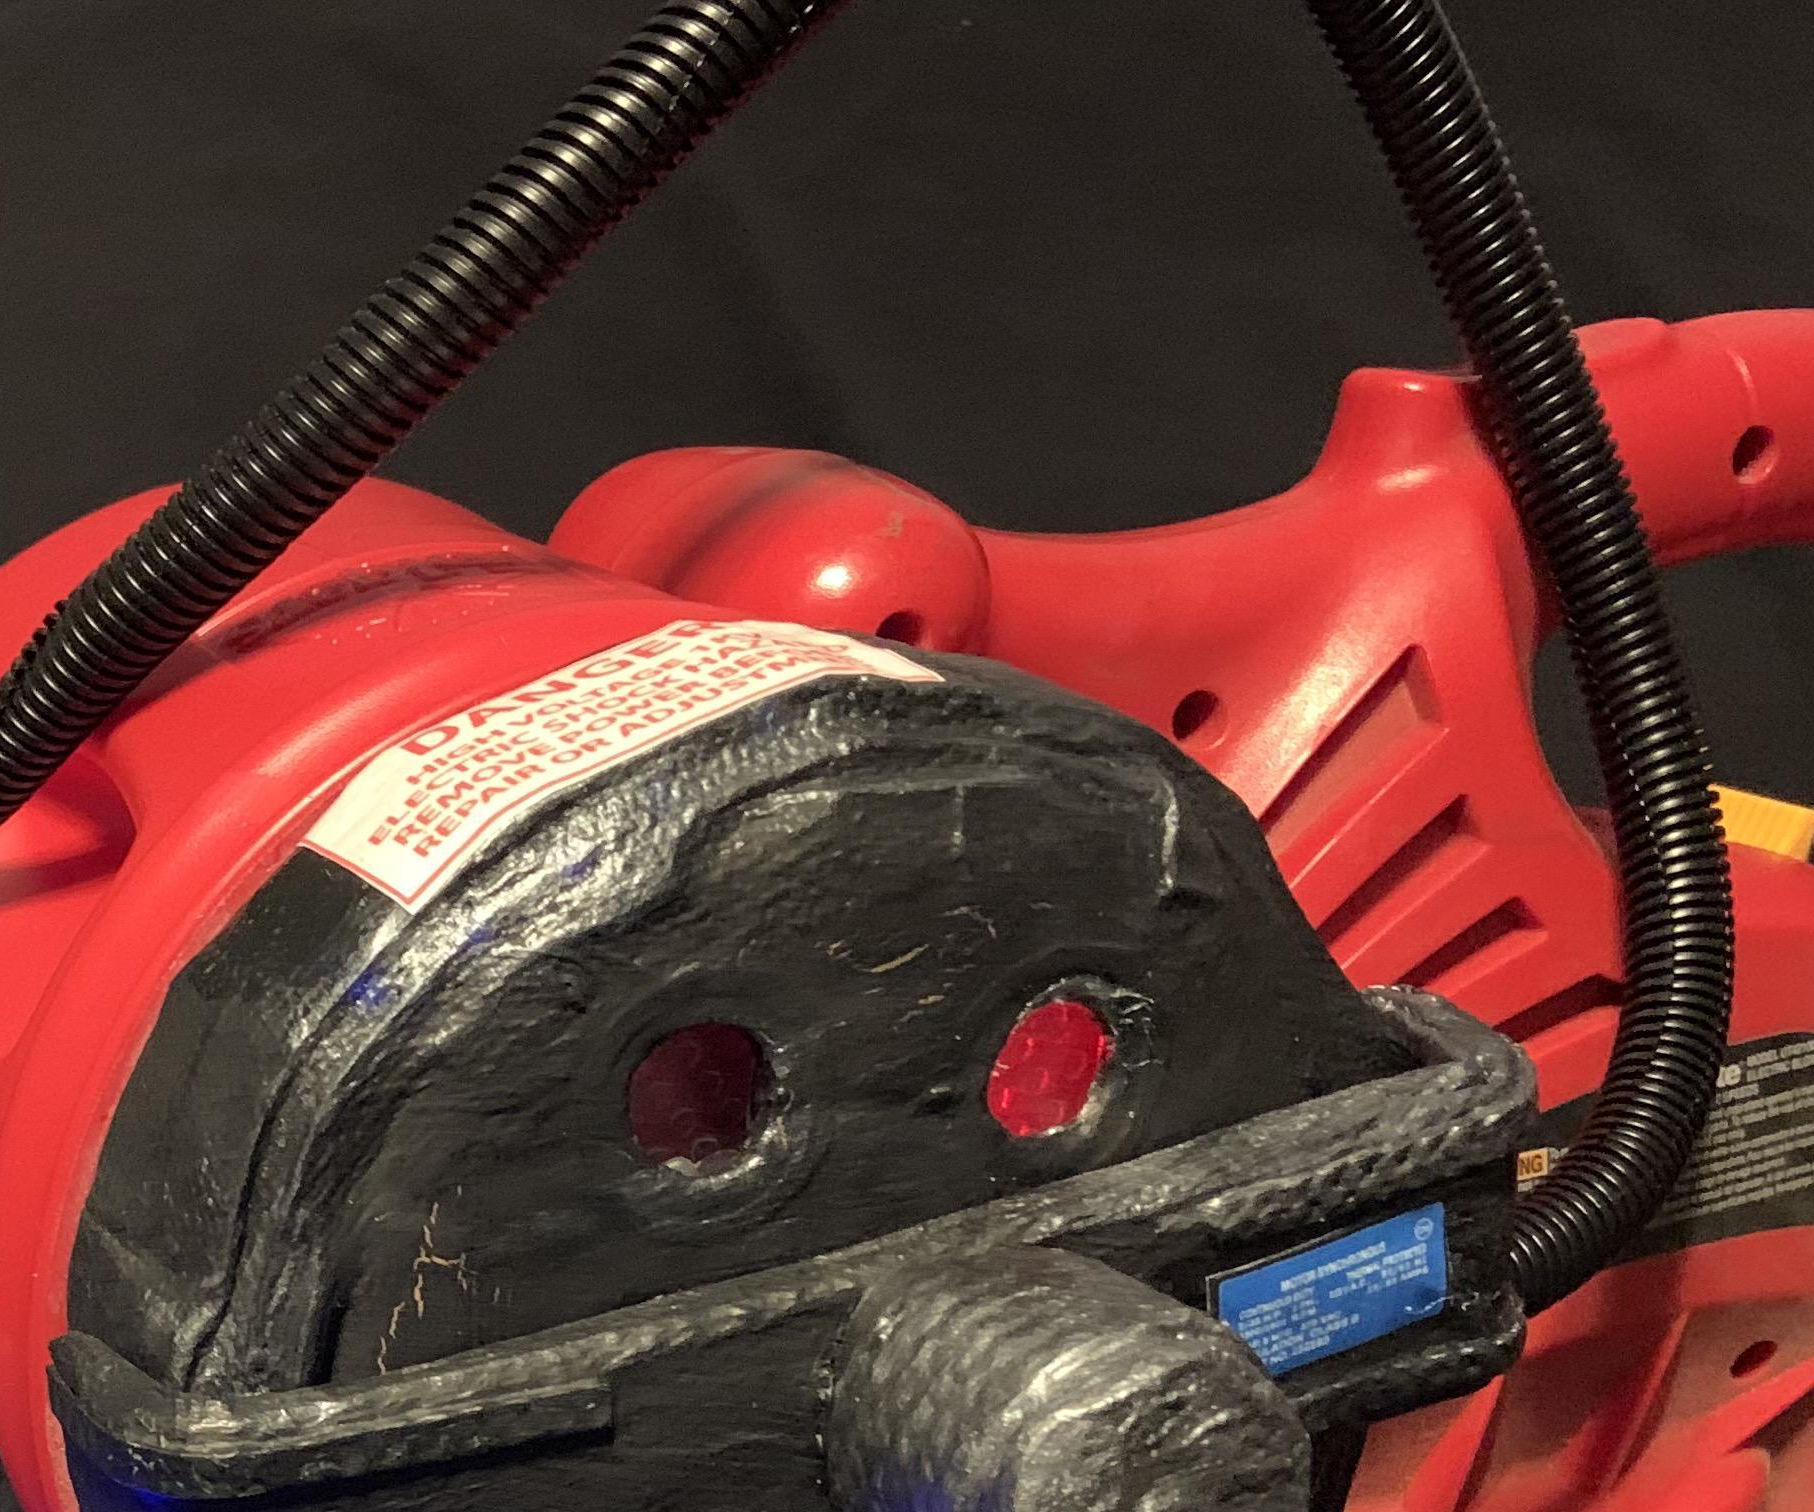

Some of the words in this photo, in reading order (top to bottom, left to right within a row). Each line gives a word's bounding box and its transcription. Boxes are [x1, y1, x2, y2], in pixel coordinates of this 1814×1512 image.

[368, 731, 538, 845] ELECTRIC
[542, 675, 679, 732] SHOCK
[393, 743, 557, 846] REMOVE
[560, 681, 711, 744] POWER
[401, 622, 727, 756] DANGER
[406, 730, 506, 785] HIGH
[507, 658, 686, 727] VOLTAGE
[413, 764, 545, 858] REPAIR
[551, 737, 612, 764] OR
[619, 653, 861, 737] ADJUSTM
